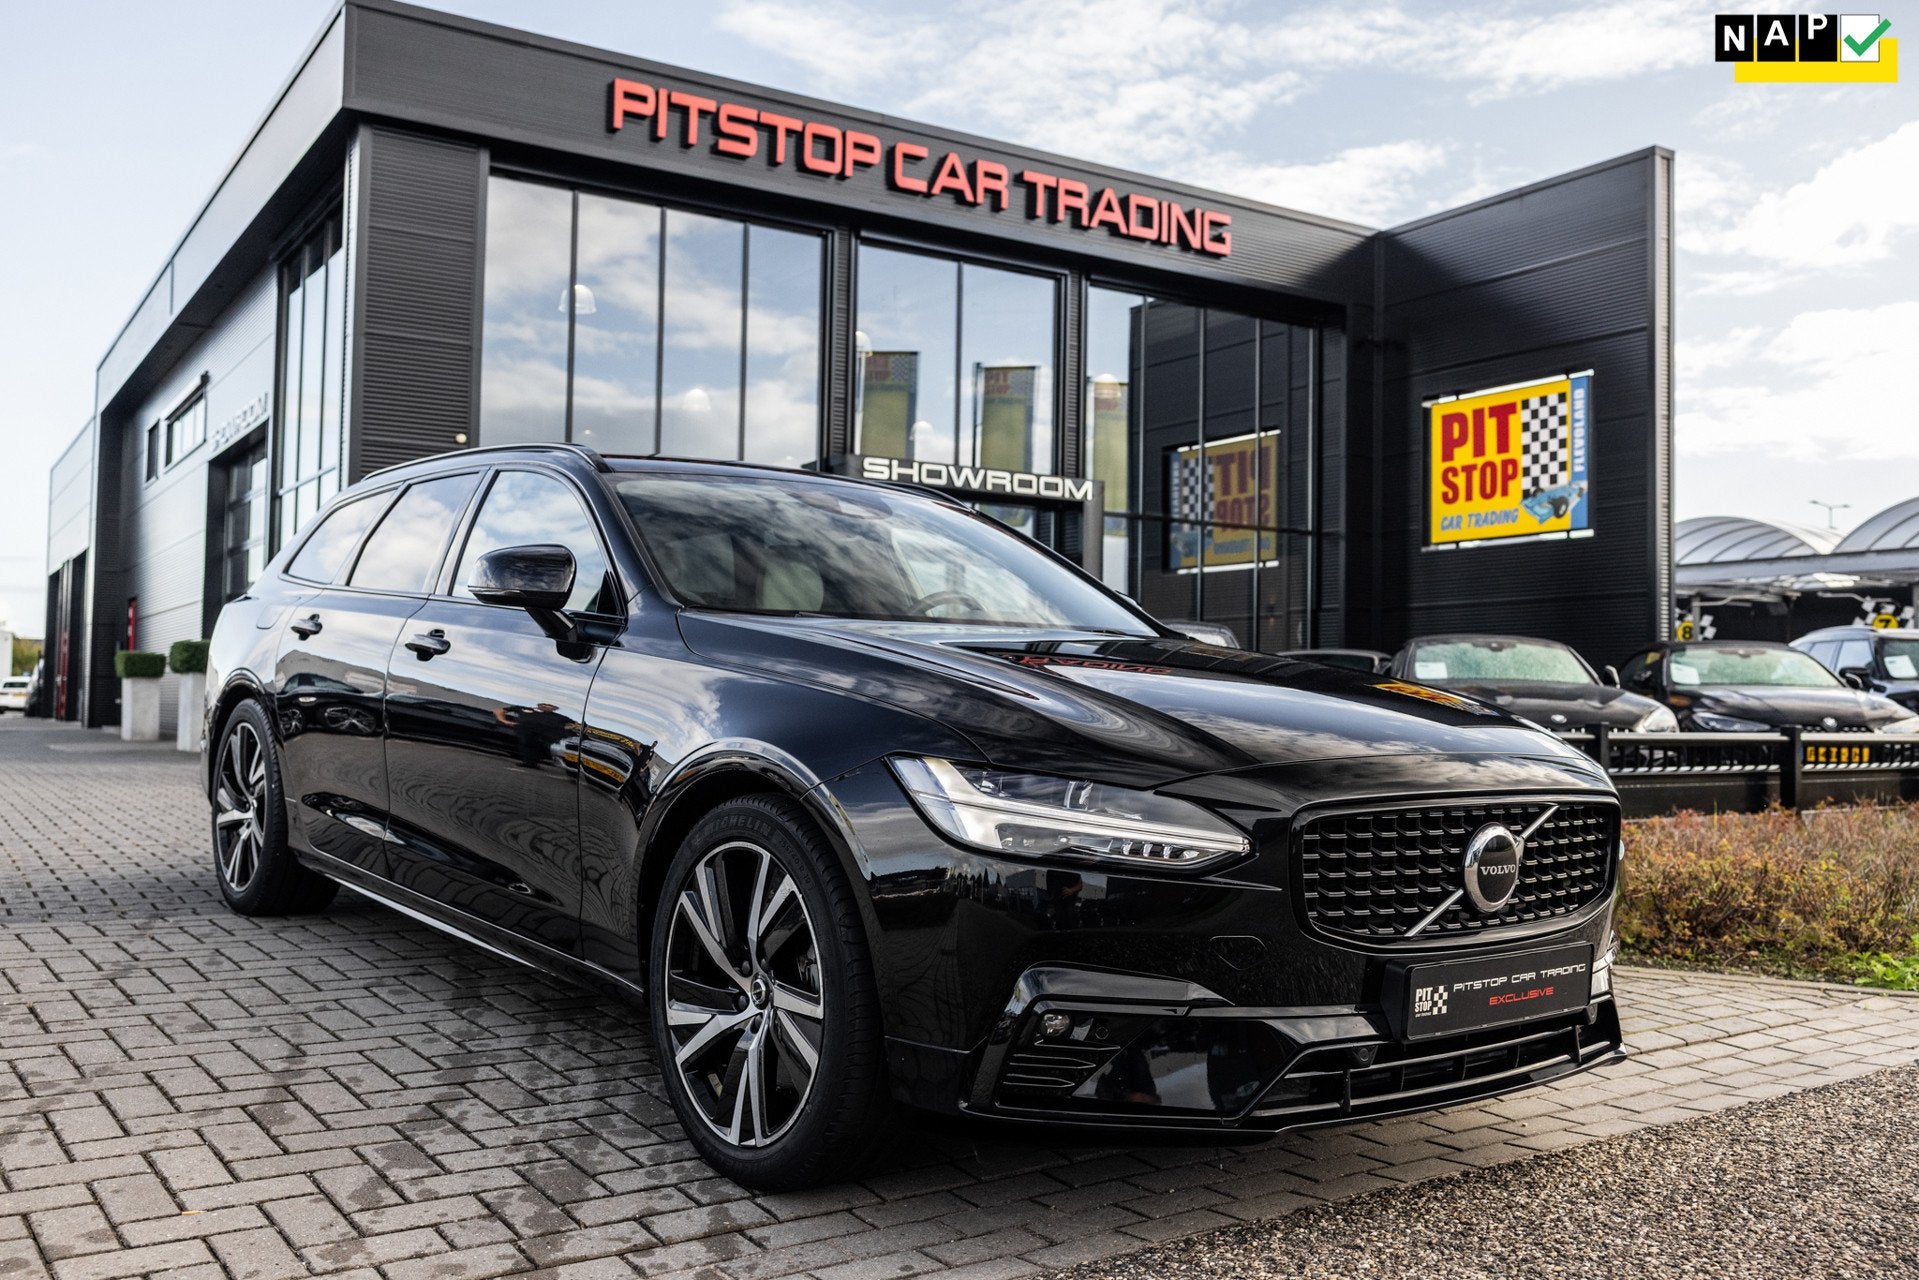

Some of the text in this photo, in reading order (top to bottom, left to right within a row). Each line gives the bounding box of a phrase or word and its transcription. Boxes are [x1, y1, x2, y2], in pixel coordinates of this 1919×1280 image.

[612, 77, 1232, 256] PITSTOP CAR TRADING
[1441, 401, 1518, 463] PIT
[1573, 387, 1586, 473] FLEVOLAND
[862, 456, 1094, 501] SHOWROOM
[1441, 458, 1519, 506] STOP
[1440, 508, 1519, 532] CAR TRADING
[1681, 624, 1693, 640] 8
[1480, 864, 1516, 876] VOLVO
[1453, 963, 1587, 993] PITSTOP CAR TRADING
[1414, 1001, 1433, 1013] STOP
[1415, 986, 1434, 1003] PIT
[1488, 986, 1555, 1007] EXCLUSIVE
